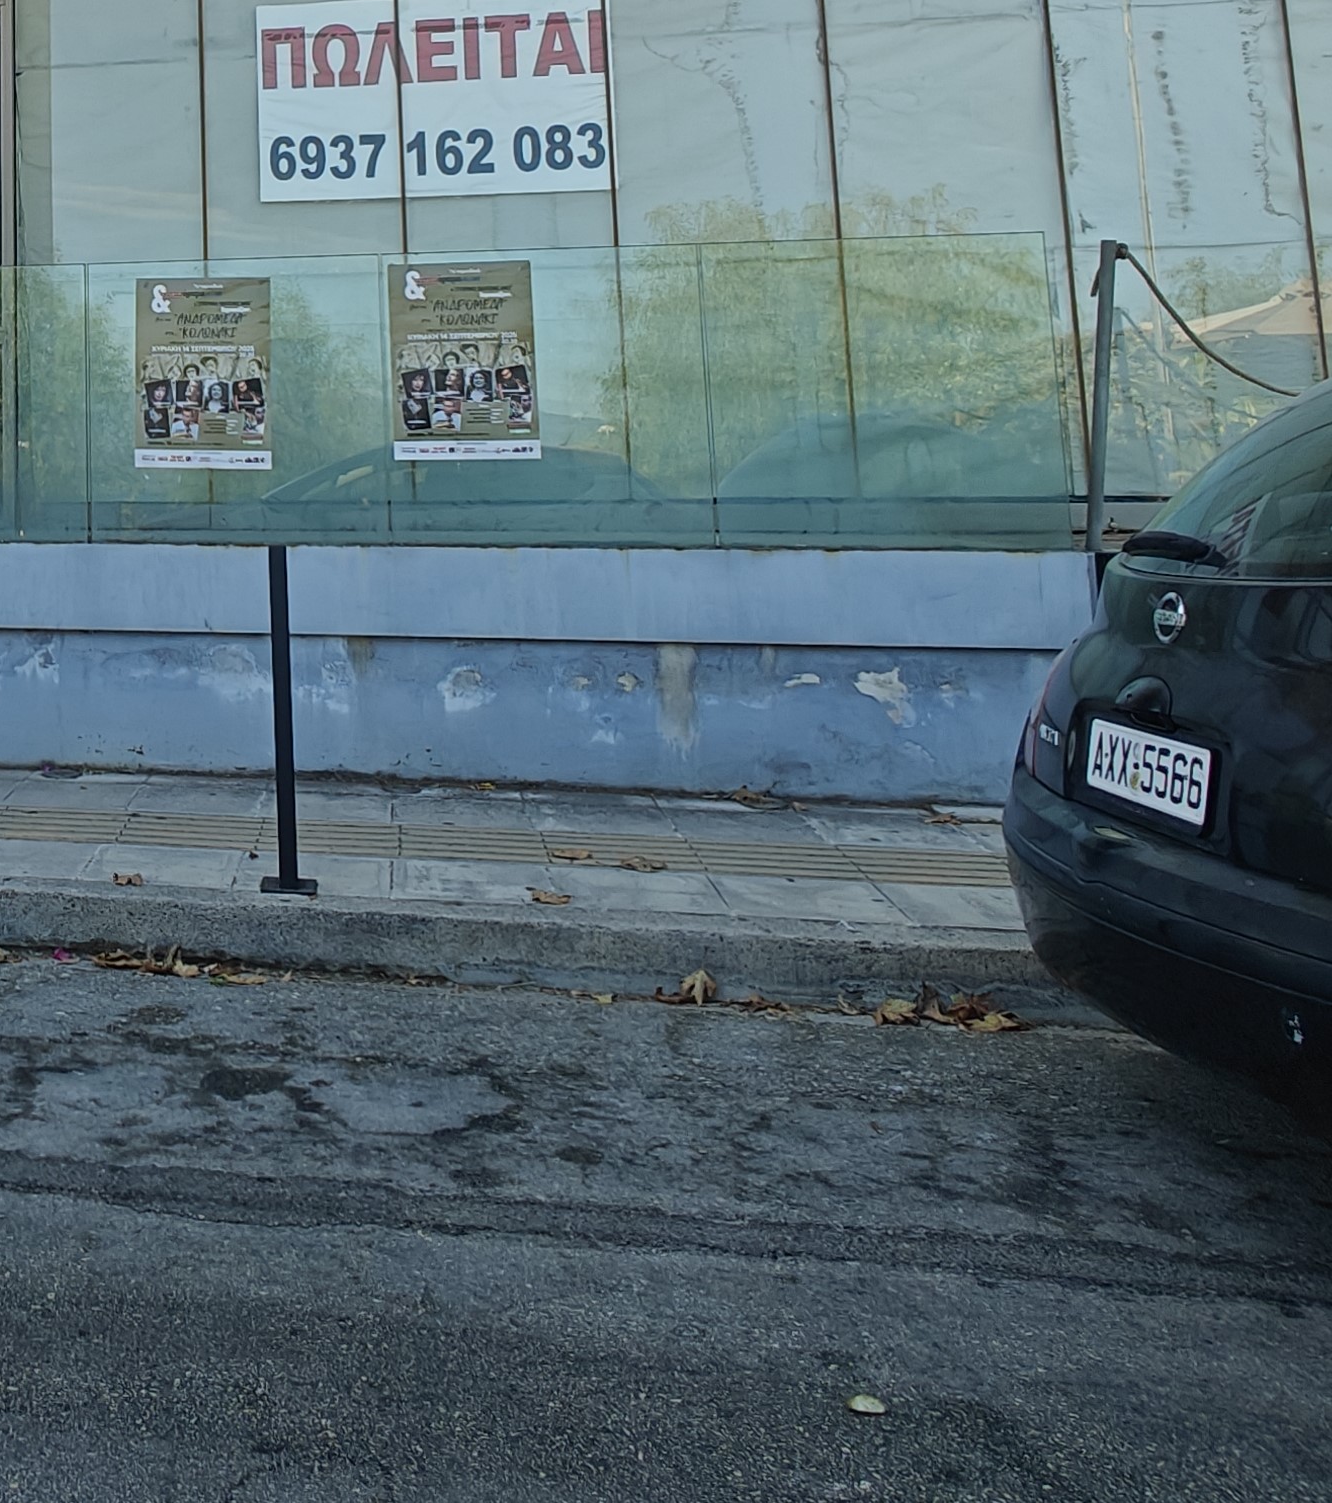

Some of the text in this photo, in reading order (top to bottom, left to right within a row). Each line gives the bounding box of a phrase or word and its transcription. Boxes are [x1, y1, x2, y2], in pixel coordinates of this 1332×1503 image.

[261, 9, 607, 91] ΠΩΛΕΙΤΑΙ
[269, 122, 606, 182] 6937 162 083
